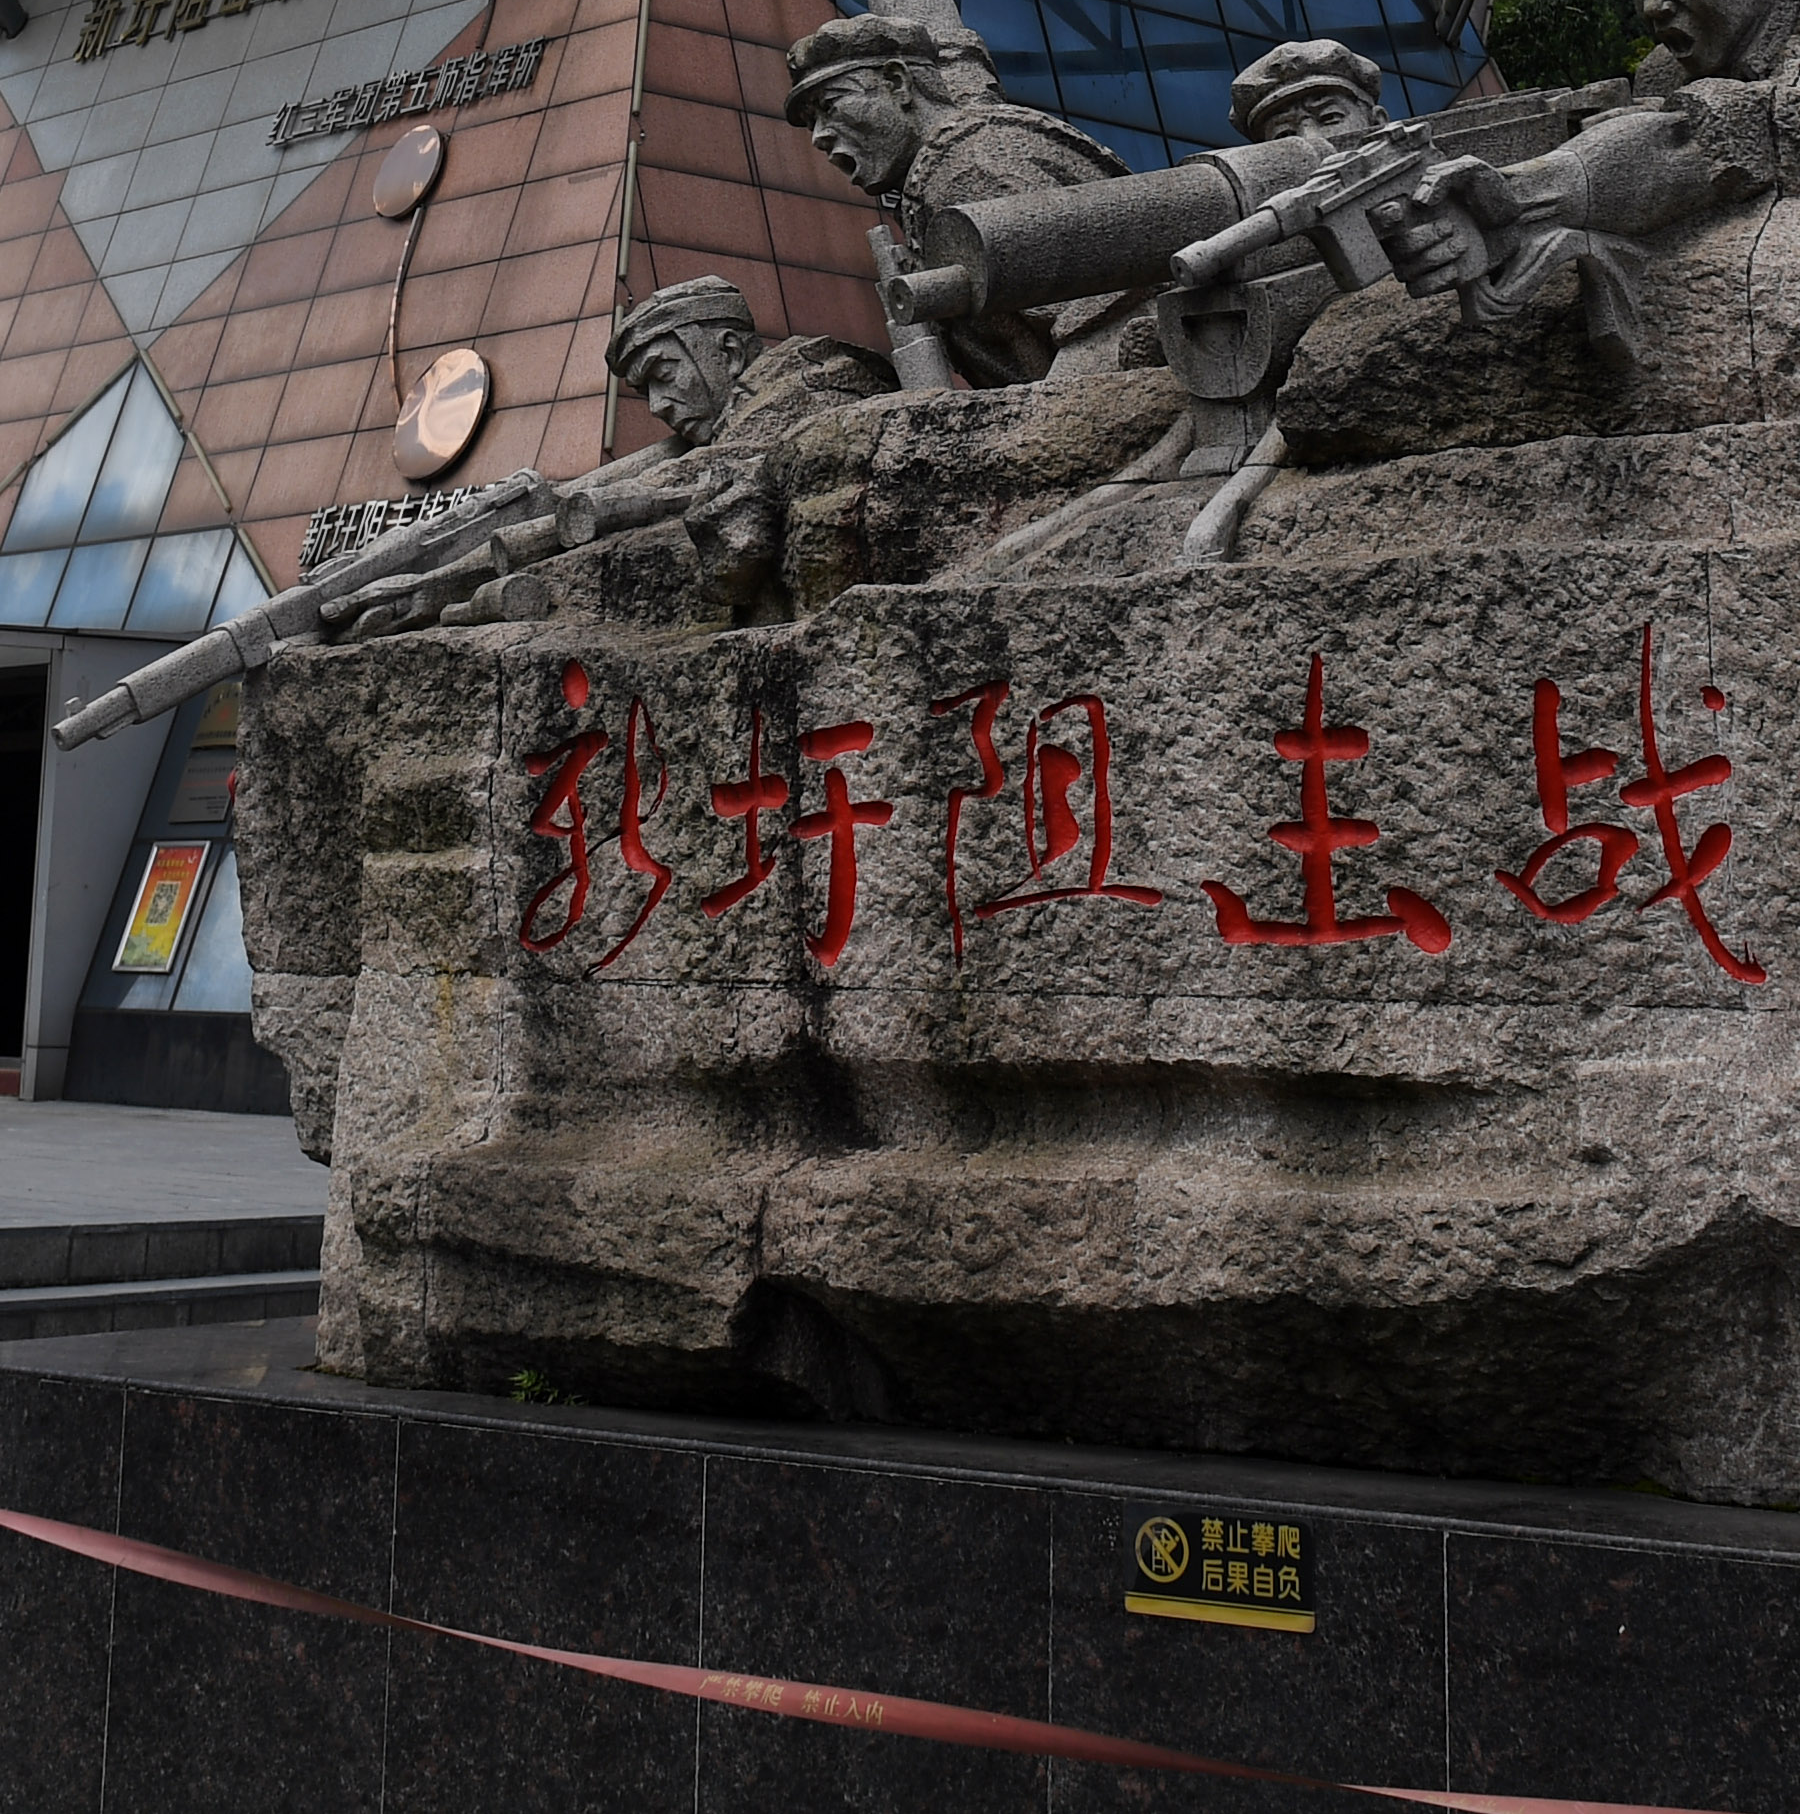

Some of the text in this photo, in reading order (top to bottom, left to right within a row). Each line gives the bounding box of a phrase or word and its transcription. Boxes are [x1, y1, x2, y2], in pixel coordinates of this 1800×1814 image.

[265, 36, 546, 147] 红三军团第五师指挥所
[519, 621, 1767, 983] 新圩阻击战
[1201, 1516, 1301, 1560] 禁止攀爬
[1201, 1559, 1301, 1601] 后果自负
[700, 1675, 884, 1725] 严禁攀爬 禁止入内
